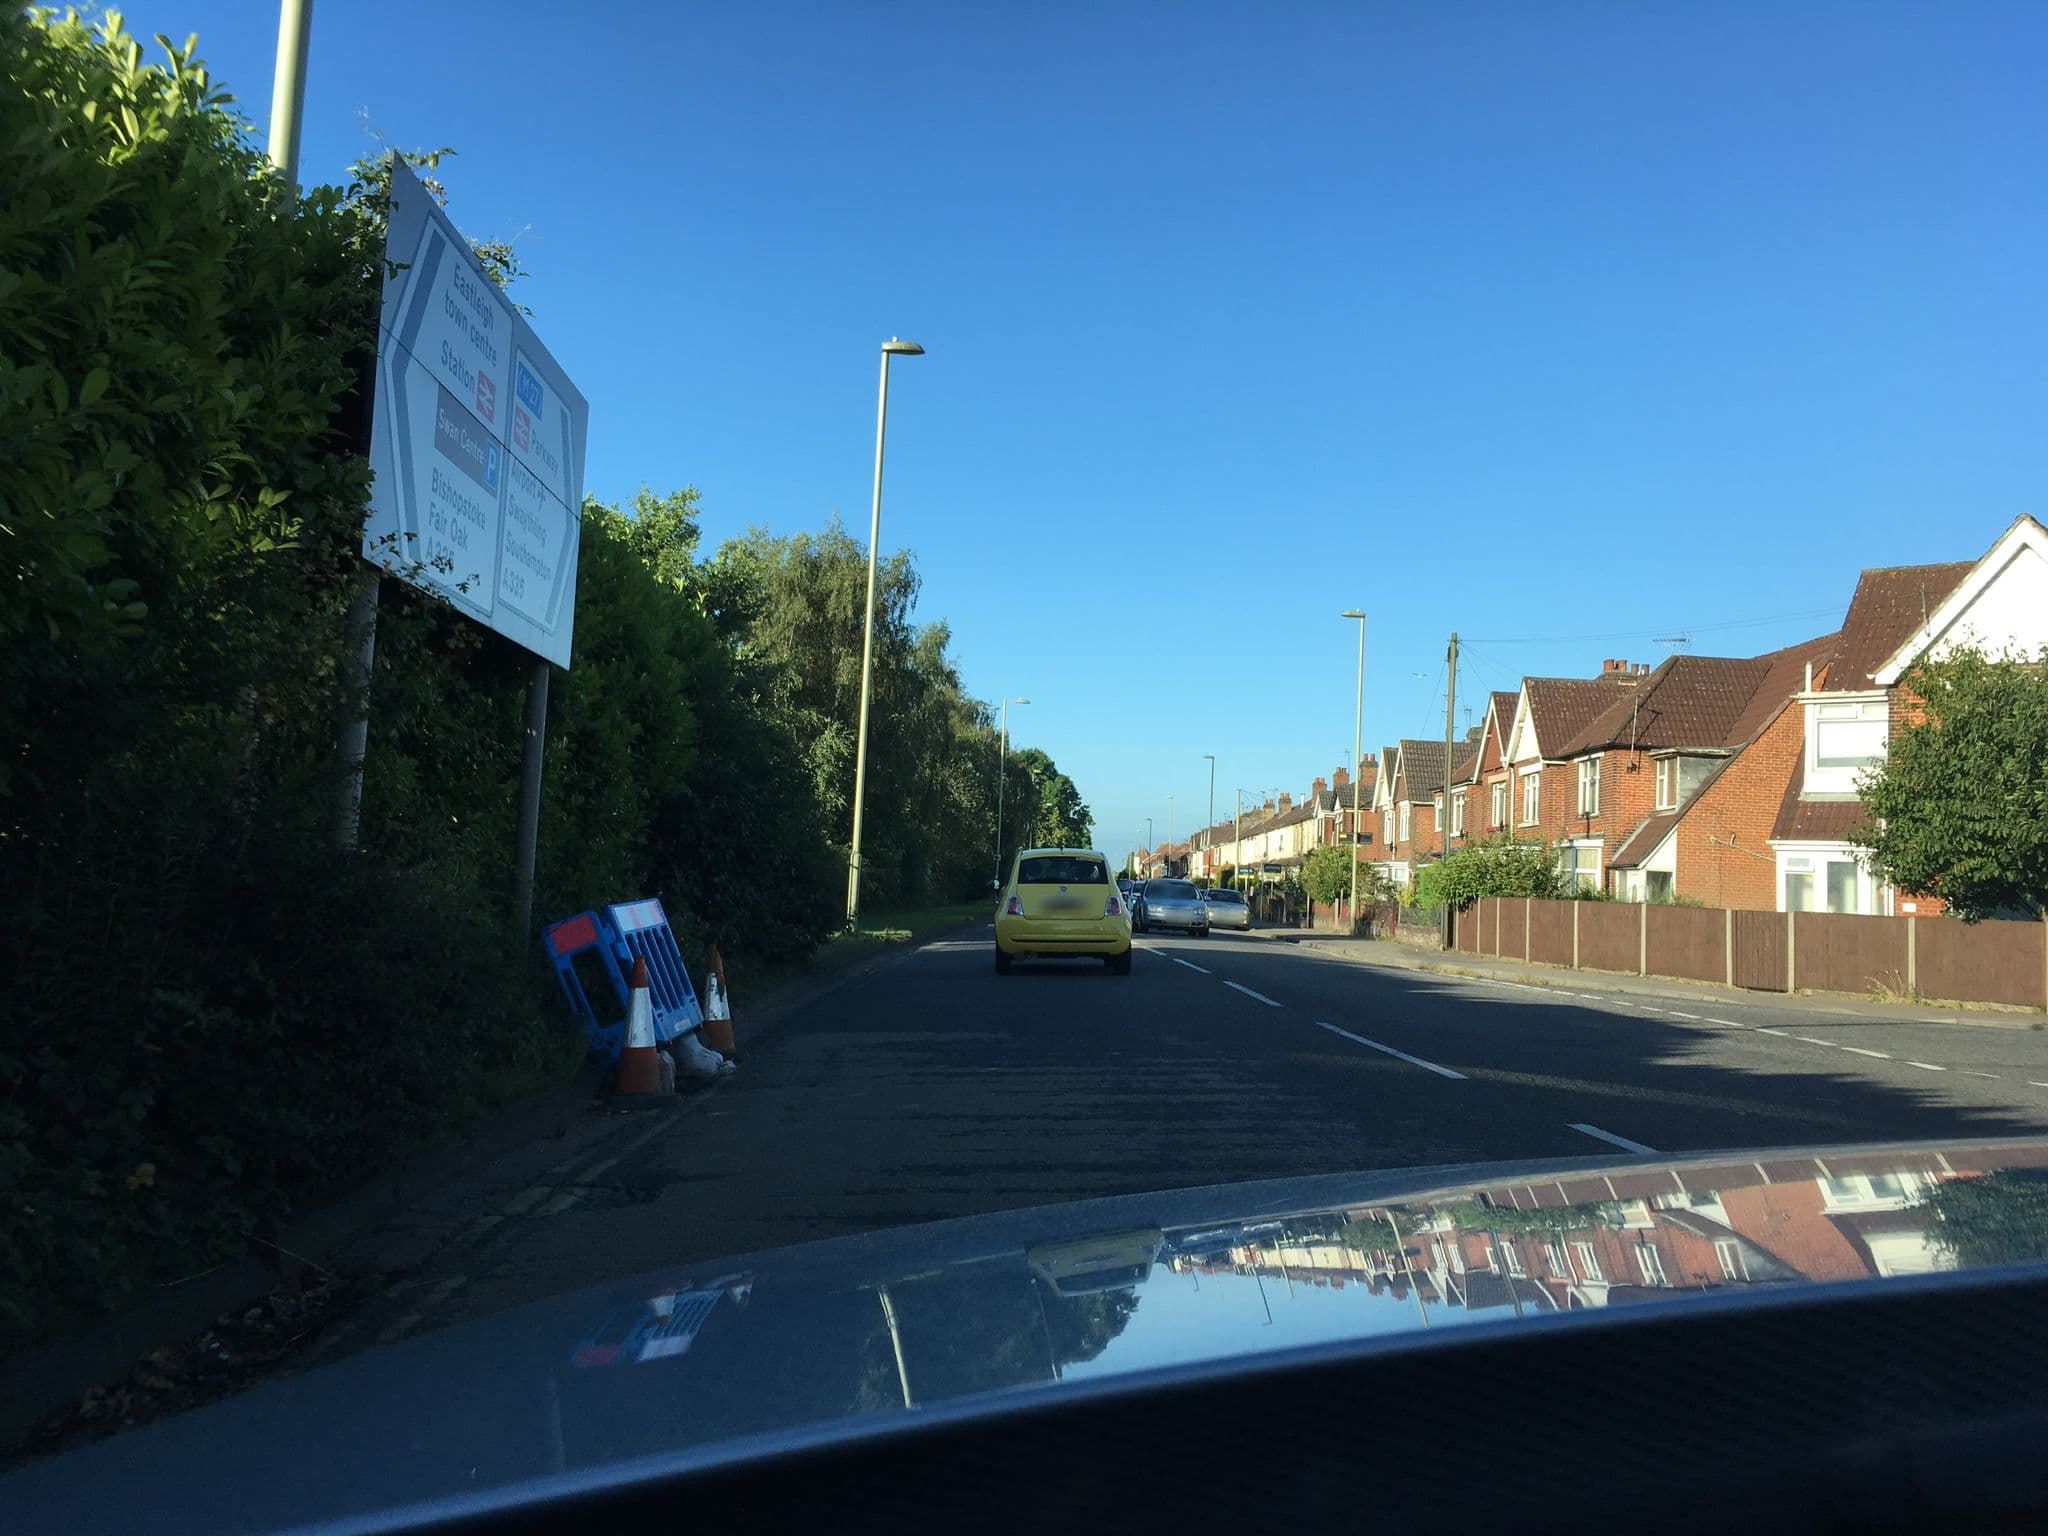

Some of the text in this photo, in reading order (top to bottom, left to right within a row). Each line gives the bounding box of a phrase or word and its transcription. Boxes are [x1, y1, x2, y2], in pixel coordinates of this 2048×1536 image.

[454, 262, 494, 331] Eastleigh
[445, 289, 497, 367] town centre
[441, 339, 475, 394] Station
[439, 407, 459, 442] Swan
[460, 428, 485, 465] Centre
[531, 429, 558, 478] Parkway
[429, 500, 468, 551] Fair Oak
[432, 466, 486, 531] Bishopstoke
[508, 493, 546, 548] Swaythling
[506, 530, 551, 580] Southampton
[503, 567, 525, 599] A335
